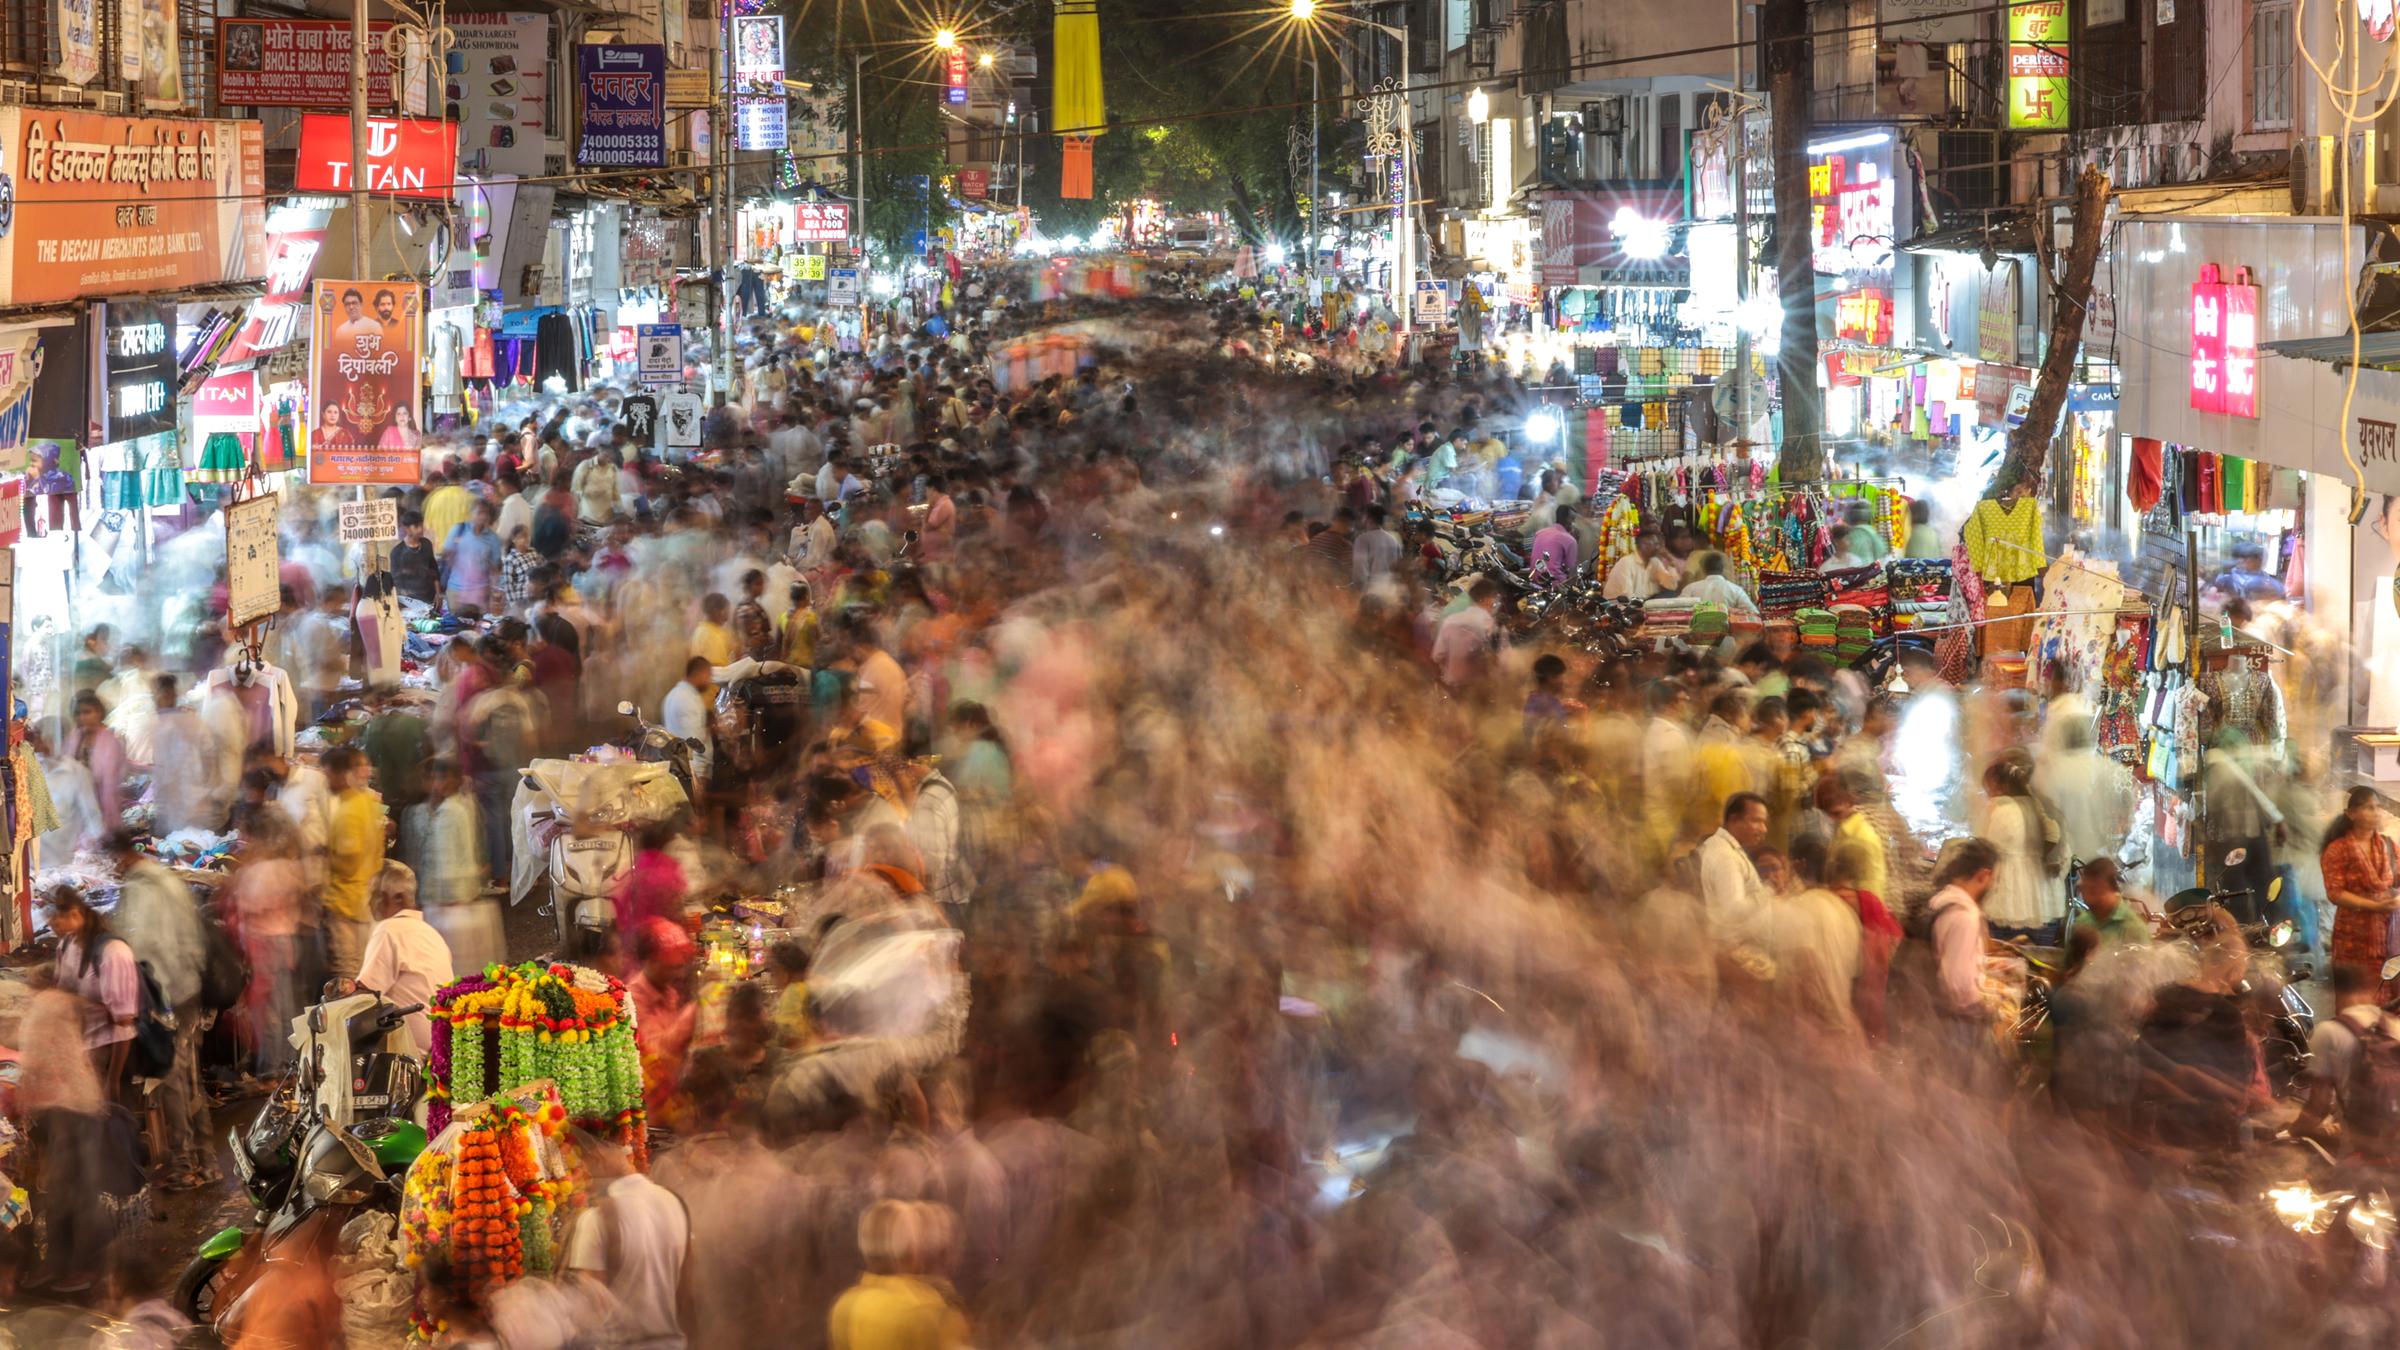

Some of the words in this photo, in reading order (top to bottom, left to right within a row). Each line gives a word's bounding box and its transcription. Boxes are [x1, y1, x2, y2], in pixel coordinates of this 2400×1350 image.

[265, 22, 295, 50] भोले
[296, 29, 324, 50] बाबा
[472, 42, 520, 50] SHOWROOM
[485, 30, 517, 39] LARGEST
[265, 51, 296, 72] BHOLE
[298, 52, 323, 73] BABA
[326, 53, 351, 73] GUES
[366, 54, 391, 73] OUSE
[589, 72, 653, 106] मनहर
[327, 162, 425, 193] TTAN
[116, 205, 135, 228] दादर
[137, 205, 157, 226] शाखा
[804, 220, 820, 229] SEA
[822, 220, 843, 229] FOOD
[37, 240, 58, 263] THE
[60, 239, 100, 263] DECCAN
[100, 236, 147, 261] MERCHANTS
[167, 233, 186, 255] BANK
[355, 334, 383, 359] शुभ
[337, 351, 400, 383] दिपावली
[2358, 417, 2397, 468] युवराज
